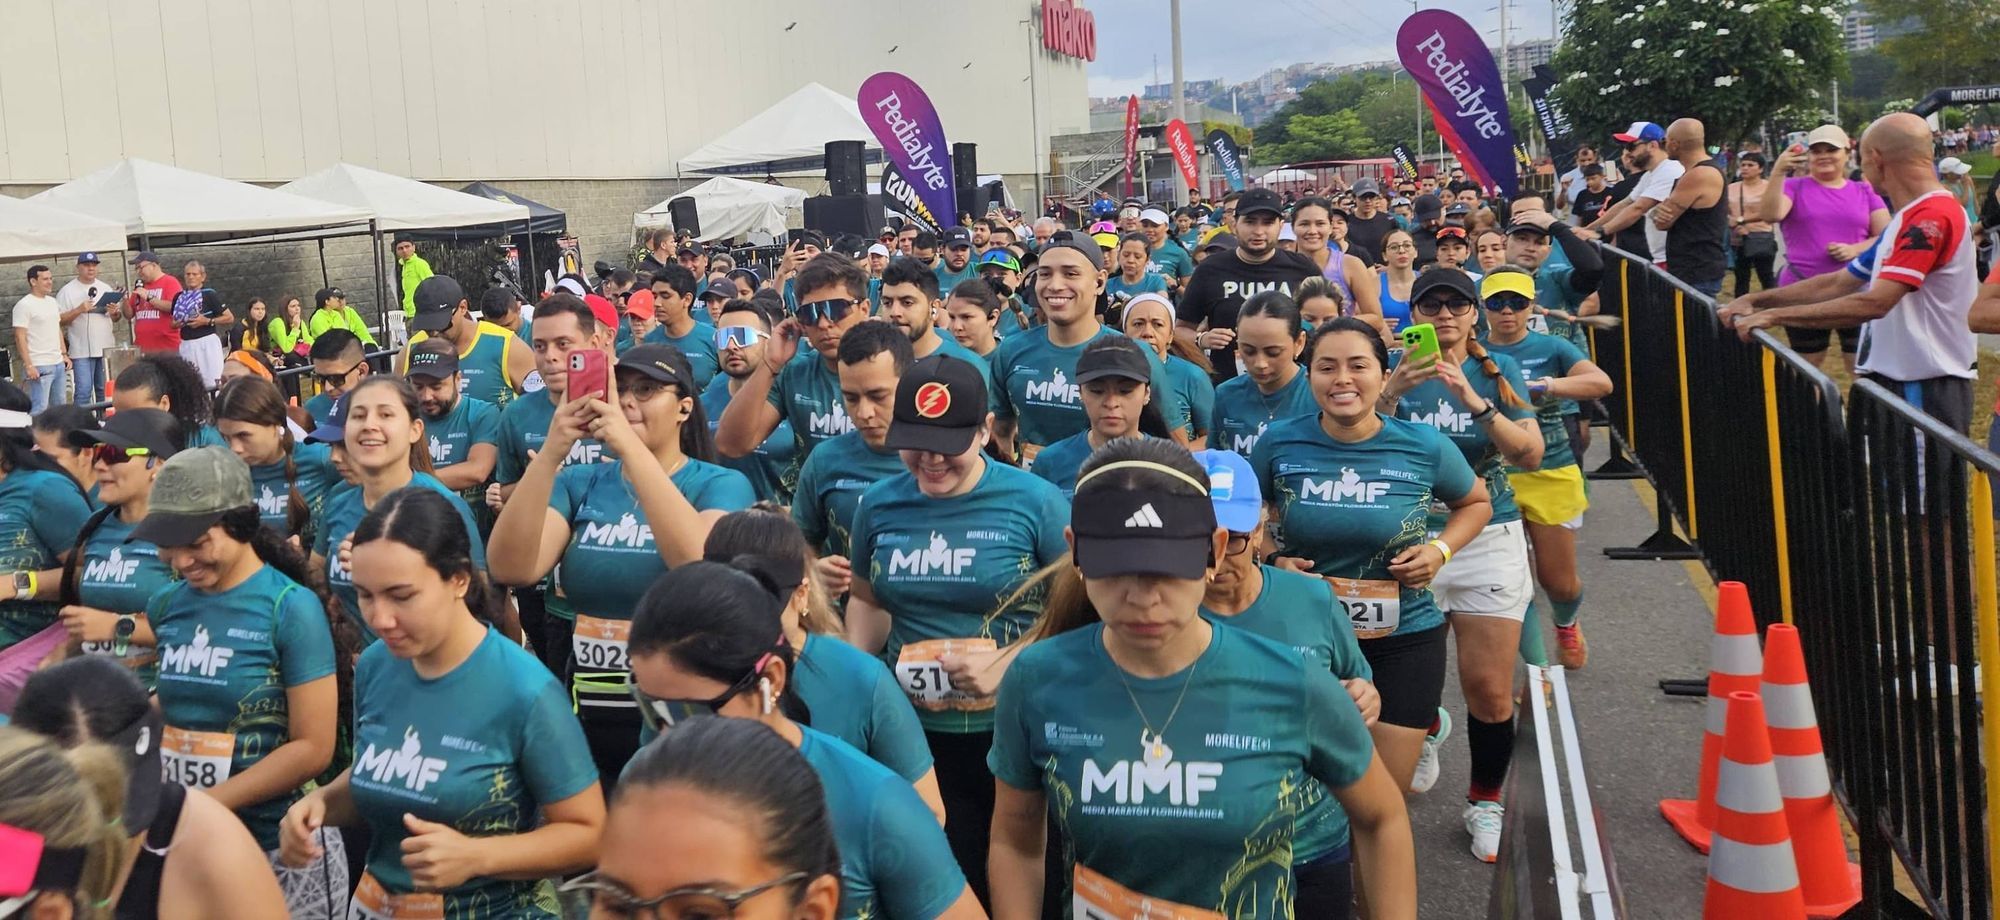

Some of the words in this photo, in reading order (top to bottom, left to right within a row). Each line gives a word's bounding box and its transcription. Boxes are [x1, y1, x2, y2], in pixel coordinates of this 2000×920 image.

[1042, 0, 1096, 62] makro
[1416, 30, 1503, 139] Pedialyte
[875, 90, 946, 190] Pedialyte
[1171, 128, 1197, 178] Pedialyte
[1213, 137, 1241, 180] Pedialyte
[1222, 280, 1292, 300] PUMA
[1026, 380, 1080, 403] MMF
[1301, 477, 1391, 503] MMF
[580, 521, 655, 548] MMF
[83, 559, 140, 583] MMF
[888, 548, 977, 576] MMF
[161, 643, 234, 677] MMF
[353, 743, 447, 791] MMF
[1080, 757, 1223, 807] MMF
[1082, 805, 1106, 816] MEDIA
